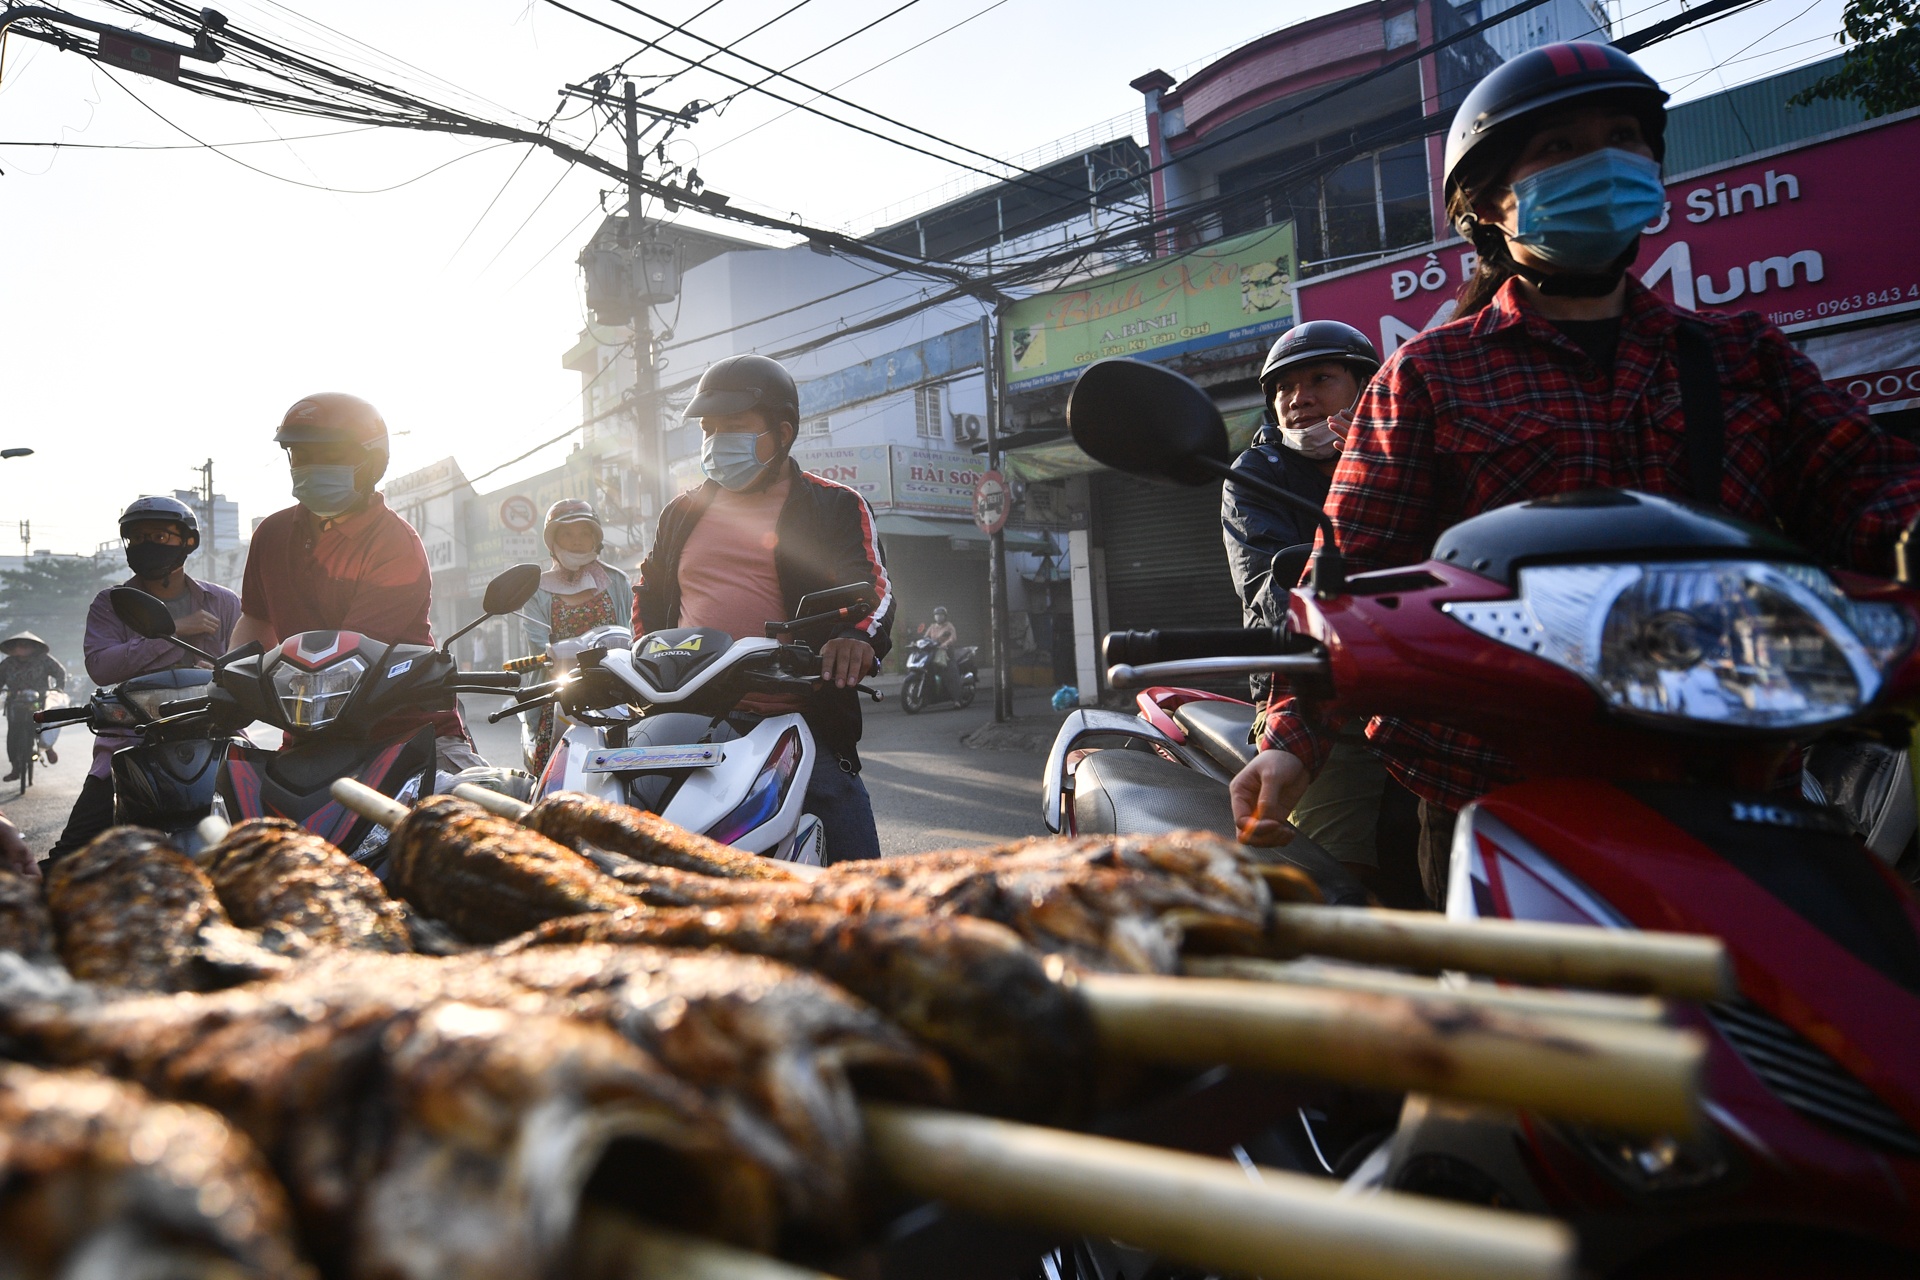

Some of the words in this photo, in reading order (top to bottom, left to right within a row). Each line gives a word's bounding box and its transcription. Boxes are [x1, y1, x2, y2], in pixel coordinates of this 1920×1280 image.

[1686, 169, 1800, 223] Sinh
[1768, 308, 1812, 325] tline:
[1817, 295, 1862, 315] 0963
[1867, 287, 1901, 305] 843
[910, 462, 945, 482] HẢI
[653, 650, 692, 659] HONDA
